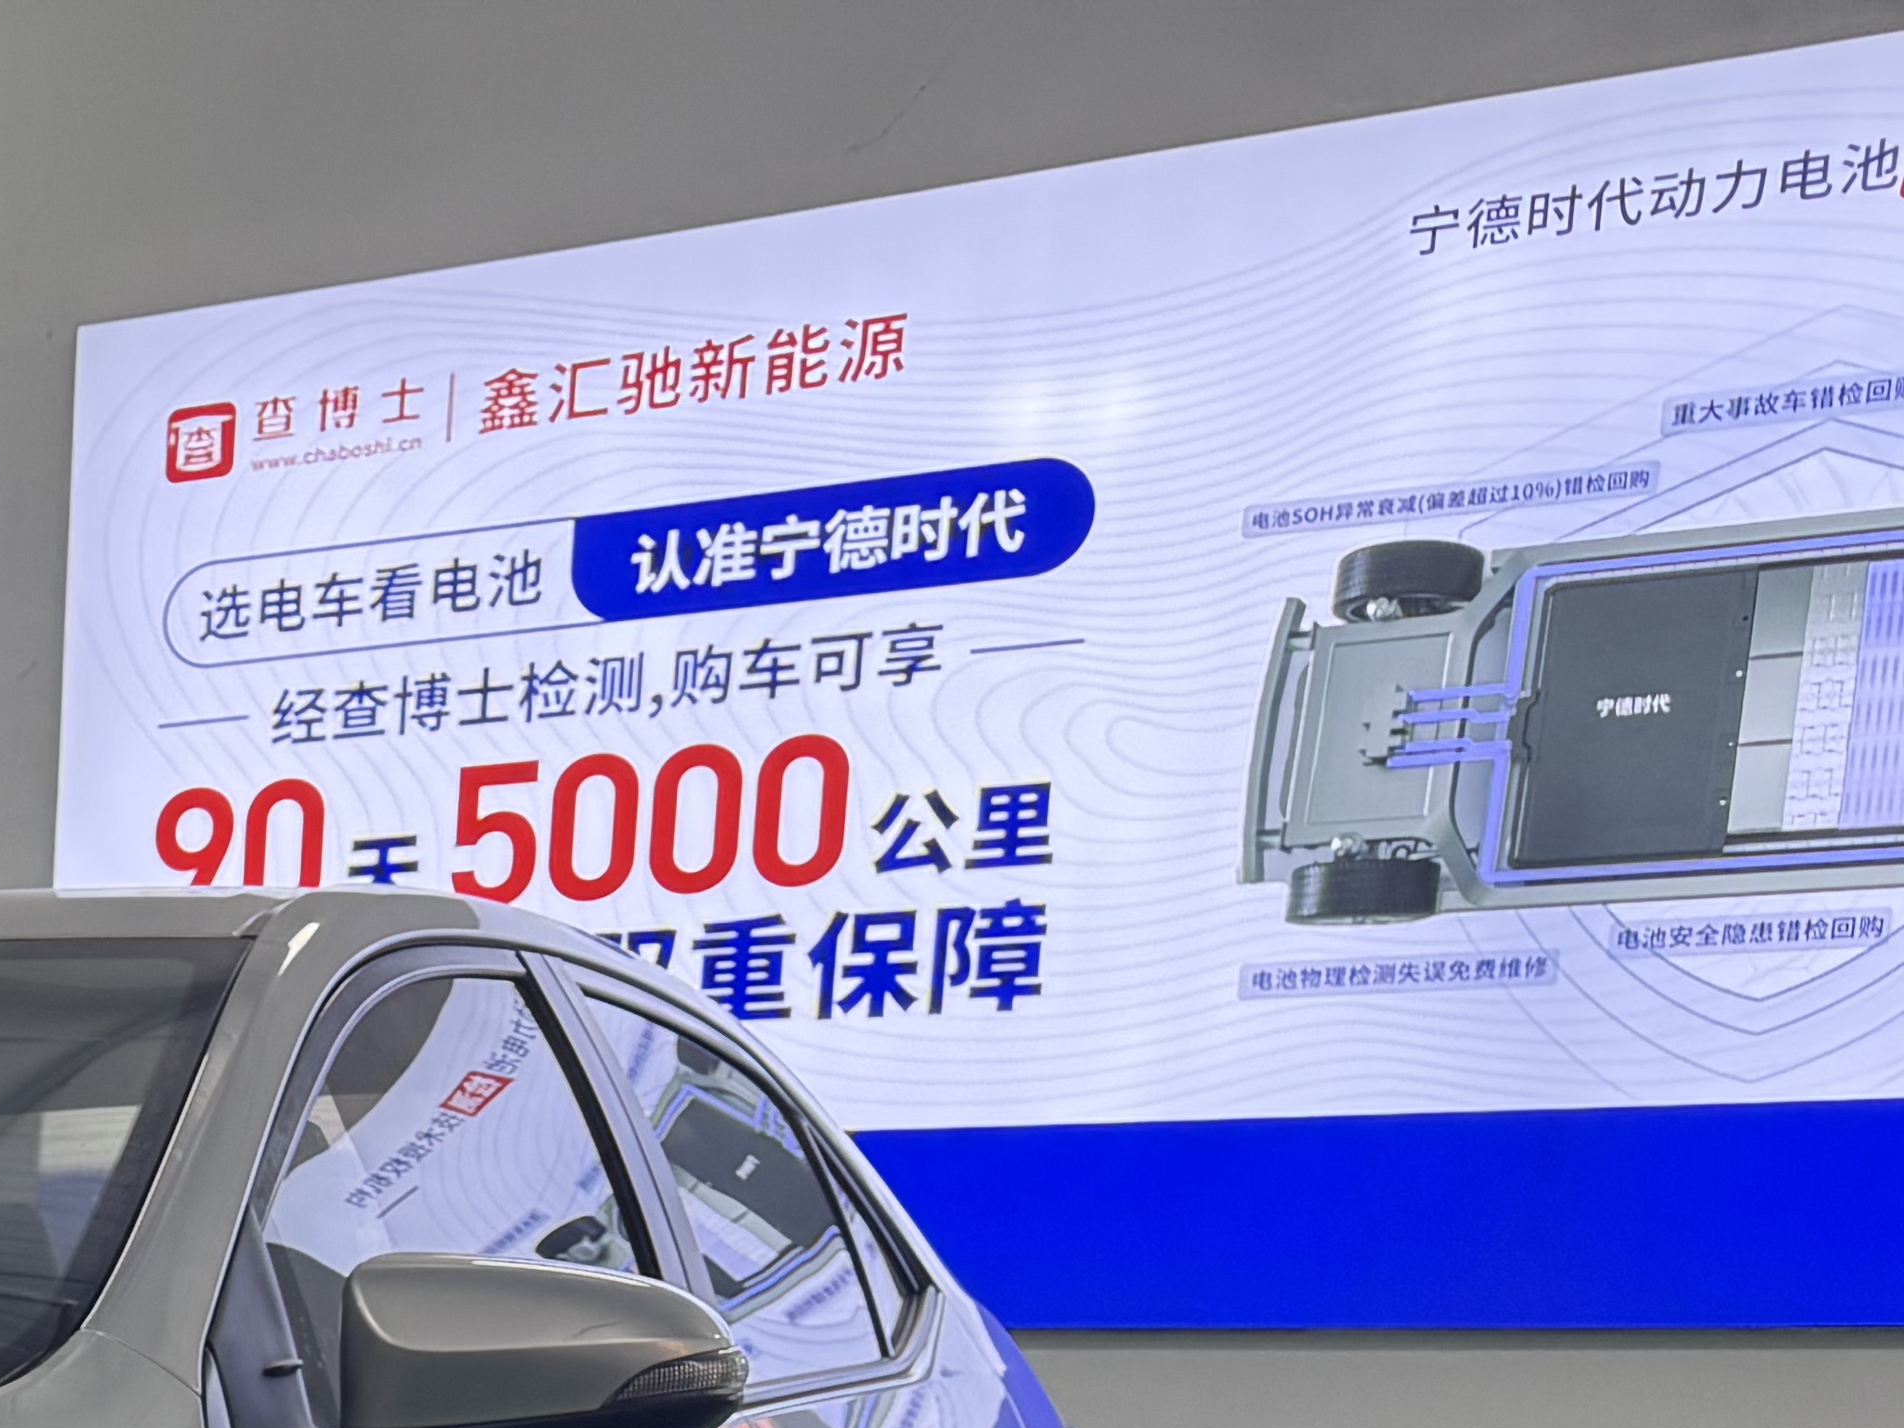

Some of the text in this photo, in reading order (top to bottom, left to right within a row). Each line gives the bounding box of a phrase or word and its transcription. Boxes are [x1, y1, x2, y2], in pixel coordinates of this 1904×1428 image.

[1409, 137, 1900, 256] 宁德时代动力电池
[478, 312, 909, 435] 鑫汇驰新能源
[197, 490, 1027, 642] 选电车看电池 认准宁德时代
[269, 621, 945, 747] 经查博士检测,购车可享
